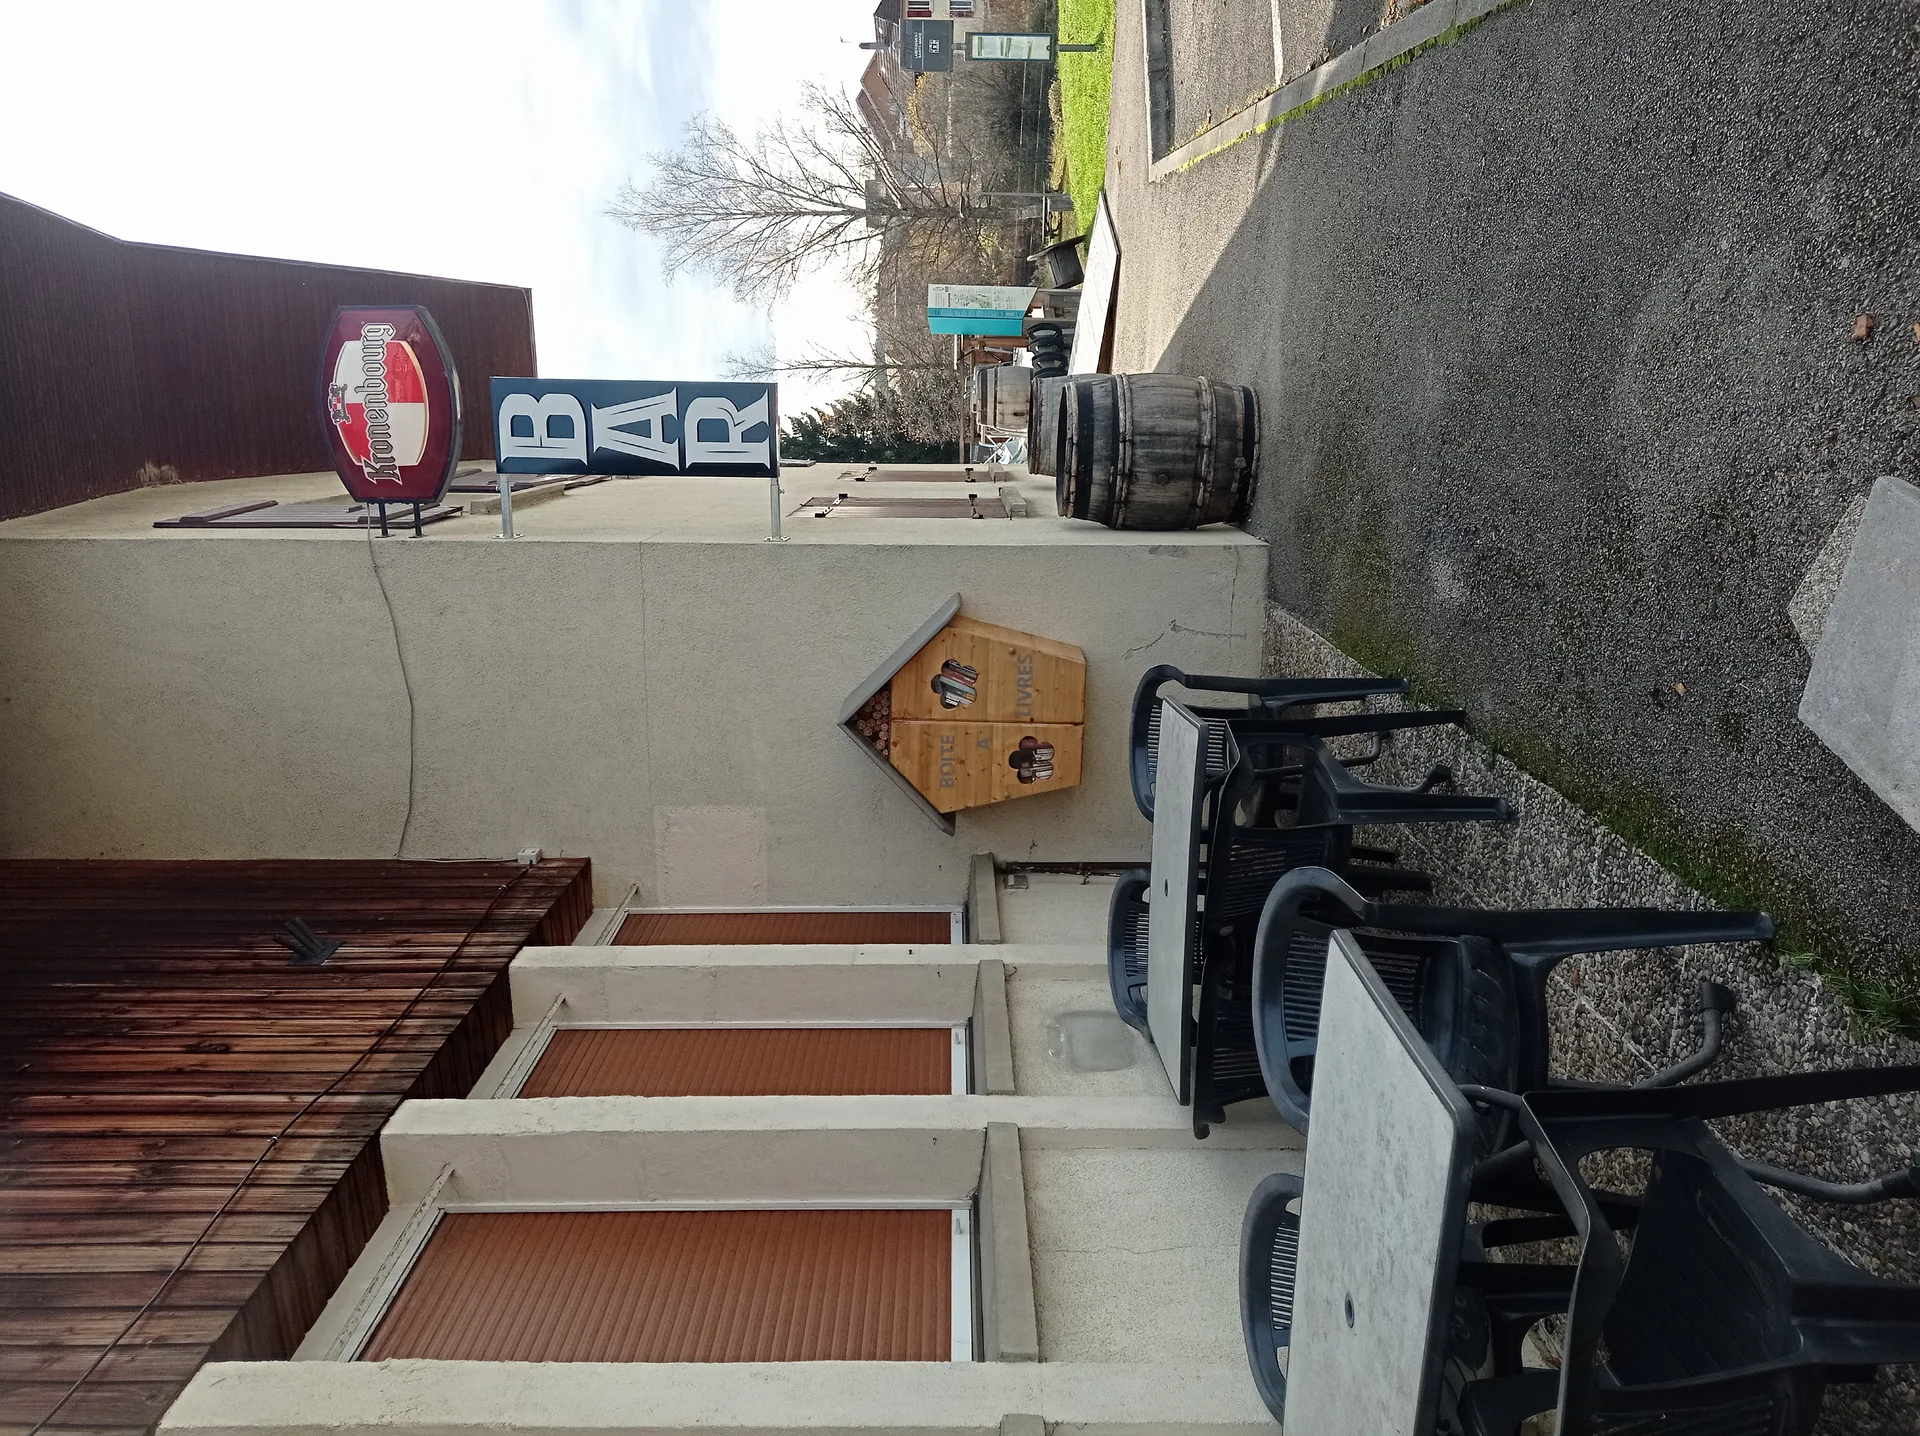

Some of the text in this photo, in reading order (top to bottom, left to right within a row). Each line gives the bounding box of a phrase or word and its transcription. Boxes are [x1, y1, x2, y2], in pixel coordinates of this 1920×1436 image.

[354, 323, 400, 484] Kronenbourg
[499, 388, 771, 470] BAR
[1016, 654, 1033, 717] LIVRES
[939, 735, 956, 788] BOITE
[977, 738, 991, 750] A
